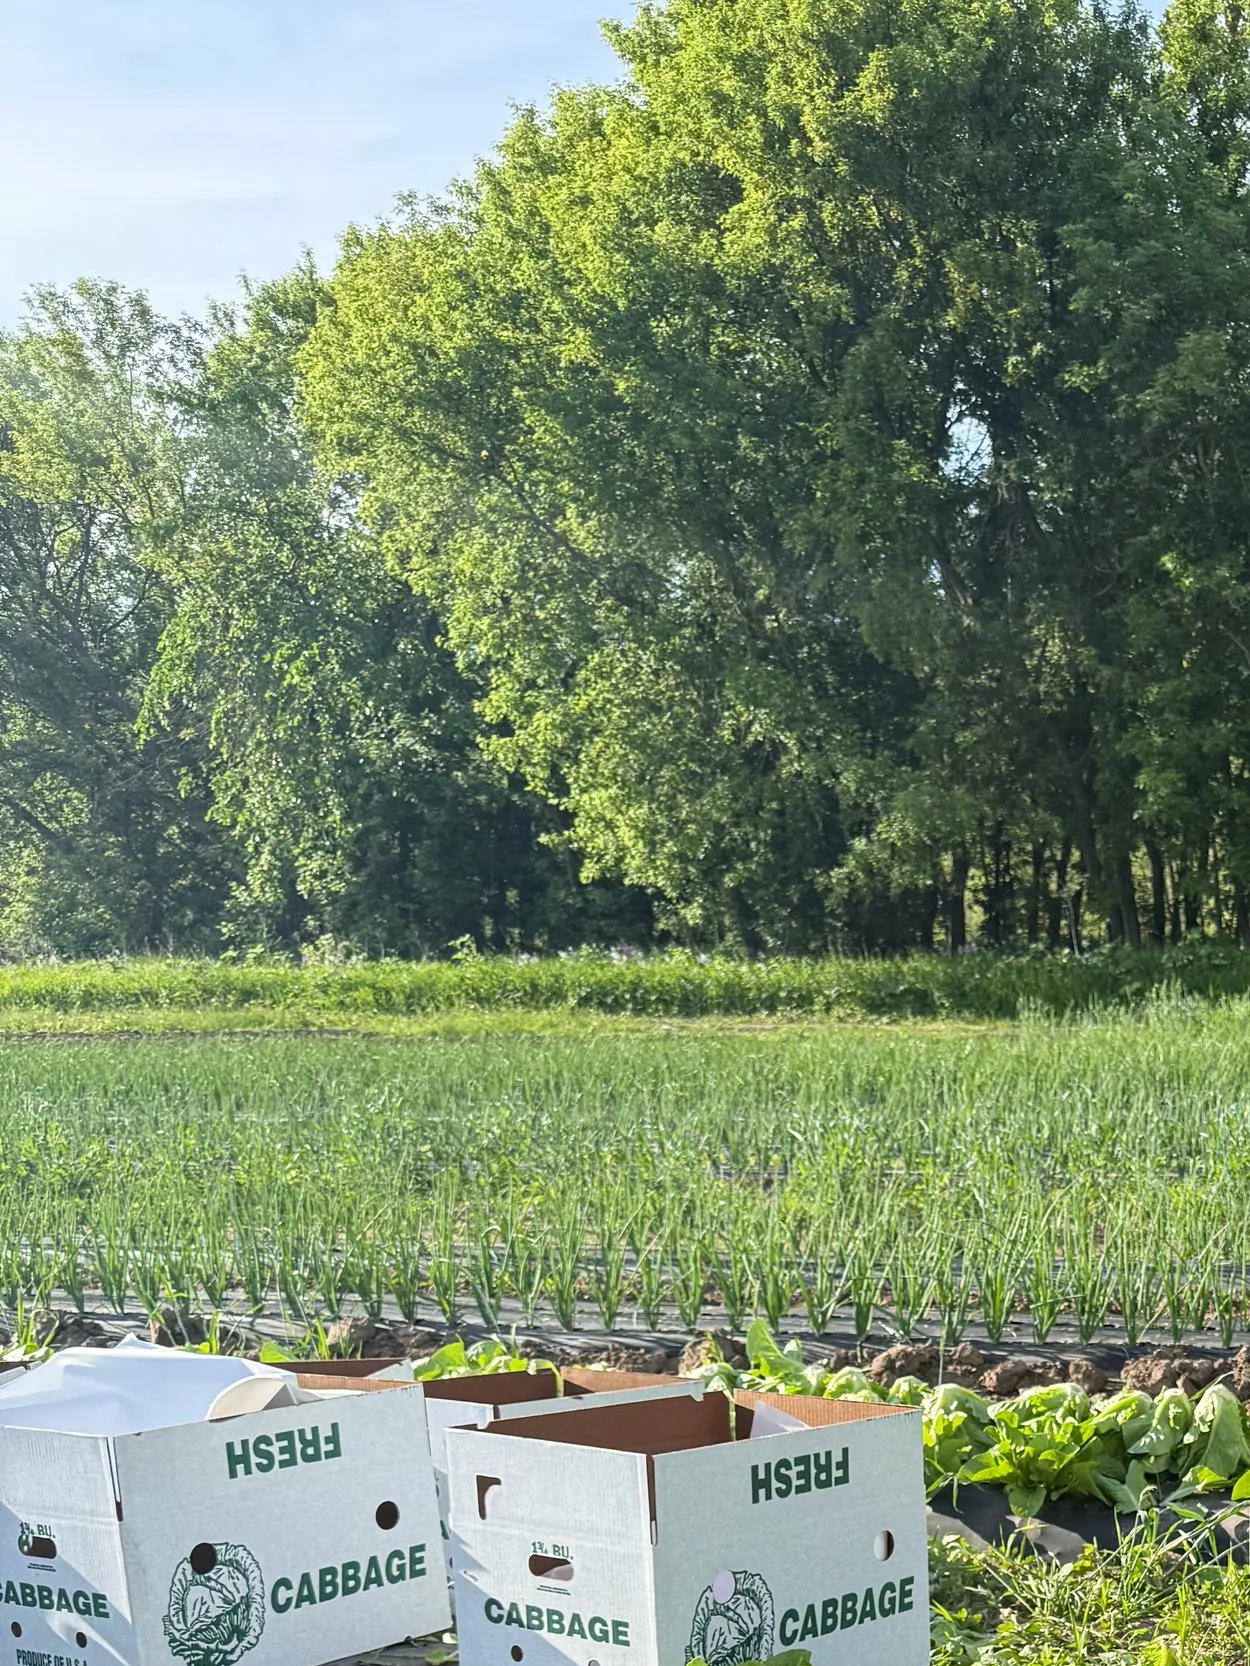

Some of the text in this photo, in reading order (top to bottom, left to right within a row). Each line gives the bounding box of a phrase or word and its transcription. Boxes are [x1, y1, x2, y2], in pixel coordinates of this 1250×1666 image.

[226, 1422, 342, 1480] FRESH
[751, 1446, 850, 1504] FRESH
[37, 1524, 56, 1538] BU.
[552, 1544, 574, 1560] BU.
[0, 1580, 110, 1618] ABBAGE
[270, 1544, 427, 1614] CABBAGE
[484, 1597, 630, 1647] CABBAGE
[779, 1575, 915, 1647] CABBAGE
